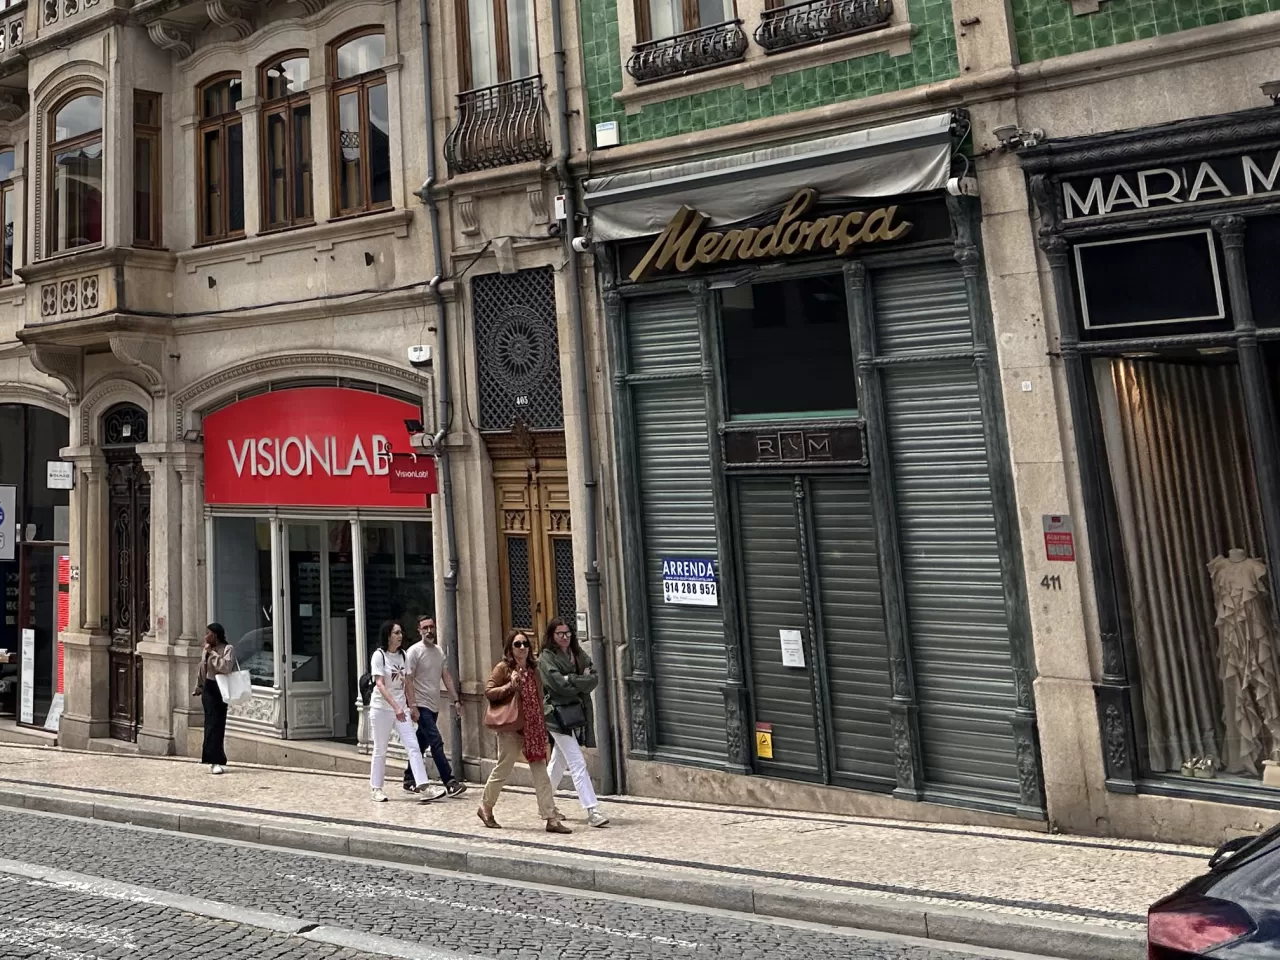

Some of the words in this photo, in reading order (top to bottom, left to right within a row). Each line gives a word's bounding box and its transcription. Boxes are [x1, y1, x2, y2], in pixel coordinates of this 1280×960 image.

[1062, 161, 1232, 219] MARIA
[628, 188, 914, 282] Mendonça
[757, 440, 775, 453] R
[808, 439, 829, 452] M
[227, 433, 390, 478] VISIONLAB
[662, 560, 715, 578] ARRENDA
[665, 582, 679, 594] 914
[681, 582, 697, 595] 288
[699, 583, 716, 596] 952
[1040, 574, 1062, 591] 411
